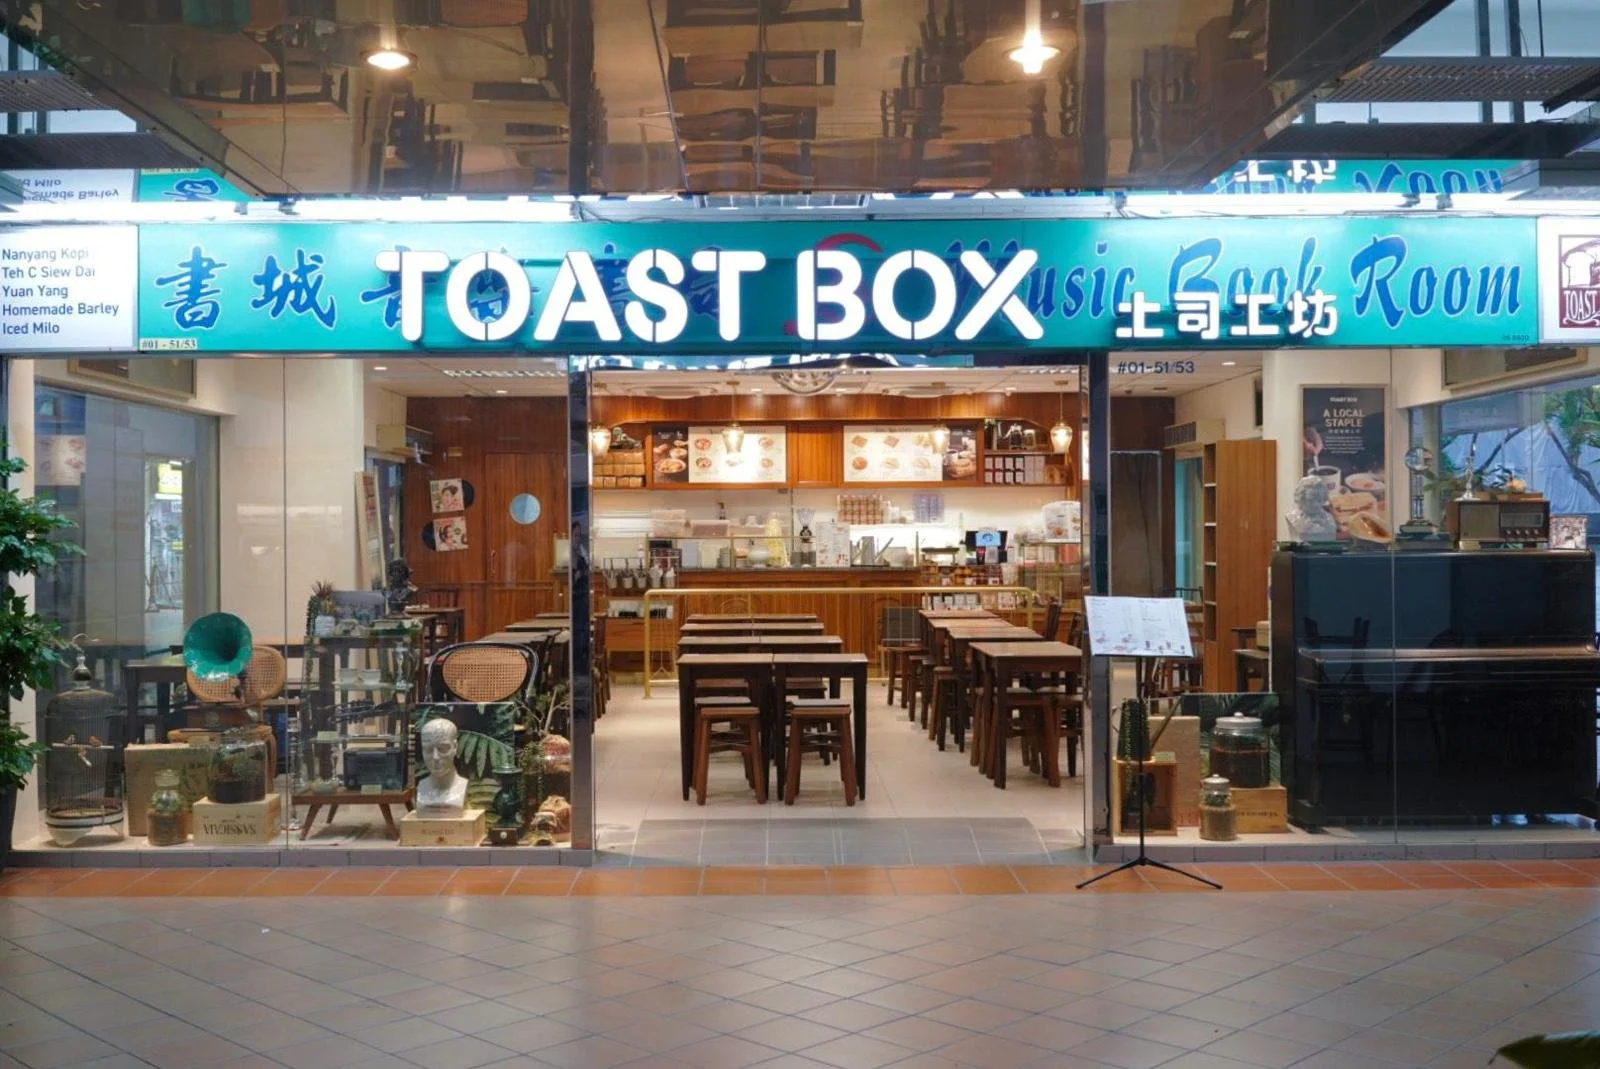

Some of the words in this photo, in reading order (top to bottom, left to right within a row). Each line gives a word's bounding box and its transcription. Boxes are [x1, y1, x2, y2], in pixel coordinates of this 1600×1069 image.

[2, 248, 57, 263] Nanyang
[61, 247, 89, 262] Kopi
[2, 267, 24, 278] Teh
[28, 267, 37, 278] C
[41, 266, 71, 278] Siew
[75, 265, 95, 277] Dai
[1350, 235, 1521, 329] Room
[2, 285, 33, 297] Yuan
[38, 284, 68, 299] Yang
[375, 248, 767, 343] TOAST
[797, 249, 1044, 341] BOX
[2, 303, 73, 316] Homemade
[78, 302, 119, 316] Barley
[1564, 290, 1598, 320] TOAST
[1115, 290, 1338, 340] 土司工坊
[2, 322, 28, 334] Iced
[33, 321, 60, 334] Milo
[1118, 361, 1195, 374] #01-51/53
[1323, 408, 1330, 418] A
[1333, 408, 1365, 418] LOCAL
[1325, 418, 1363, 427] STAPLE
